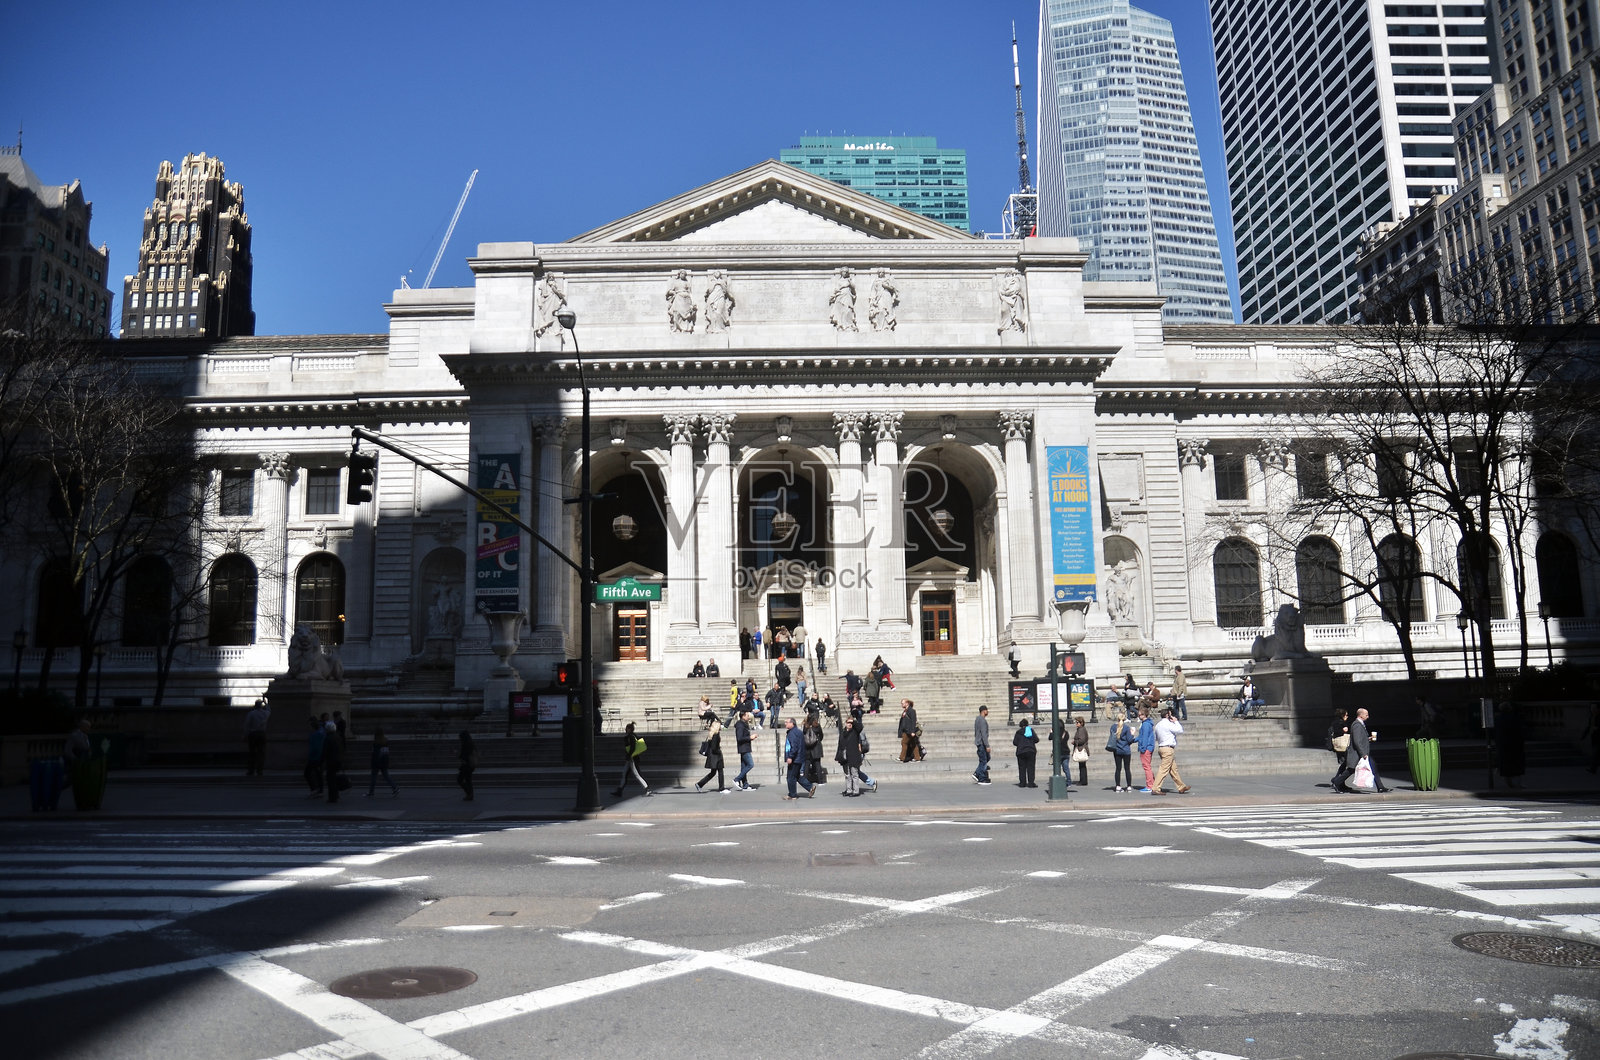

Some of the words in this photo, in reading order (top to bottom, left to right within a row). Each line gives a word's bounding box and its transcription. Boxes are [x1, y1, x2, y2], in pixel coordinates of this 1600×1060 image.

[844, 142, 895, 150] MetLife
[493, 463, 518, 490] A
[1059, 479, 1087, 490] BOOKS
[1053, 491, 1063, 502] AT
[1064, 491, 1089, 502] NOON
[477, 522, 497, 547] B
[497, 547, 518, 571] C
[477, 570, 490, 578] OF
[493, 570, 503, 578] IT
[603, 587, 627, 597] Fifth
[631, 587, 652, 597] Ave
